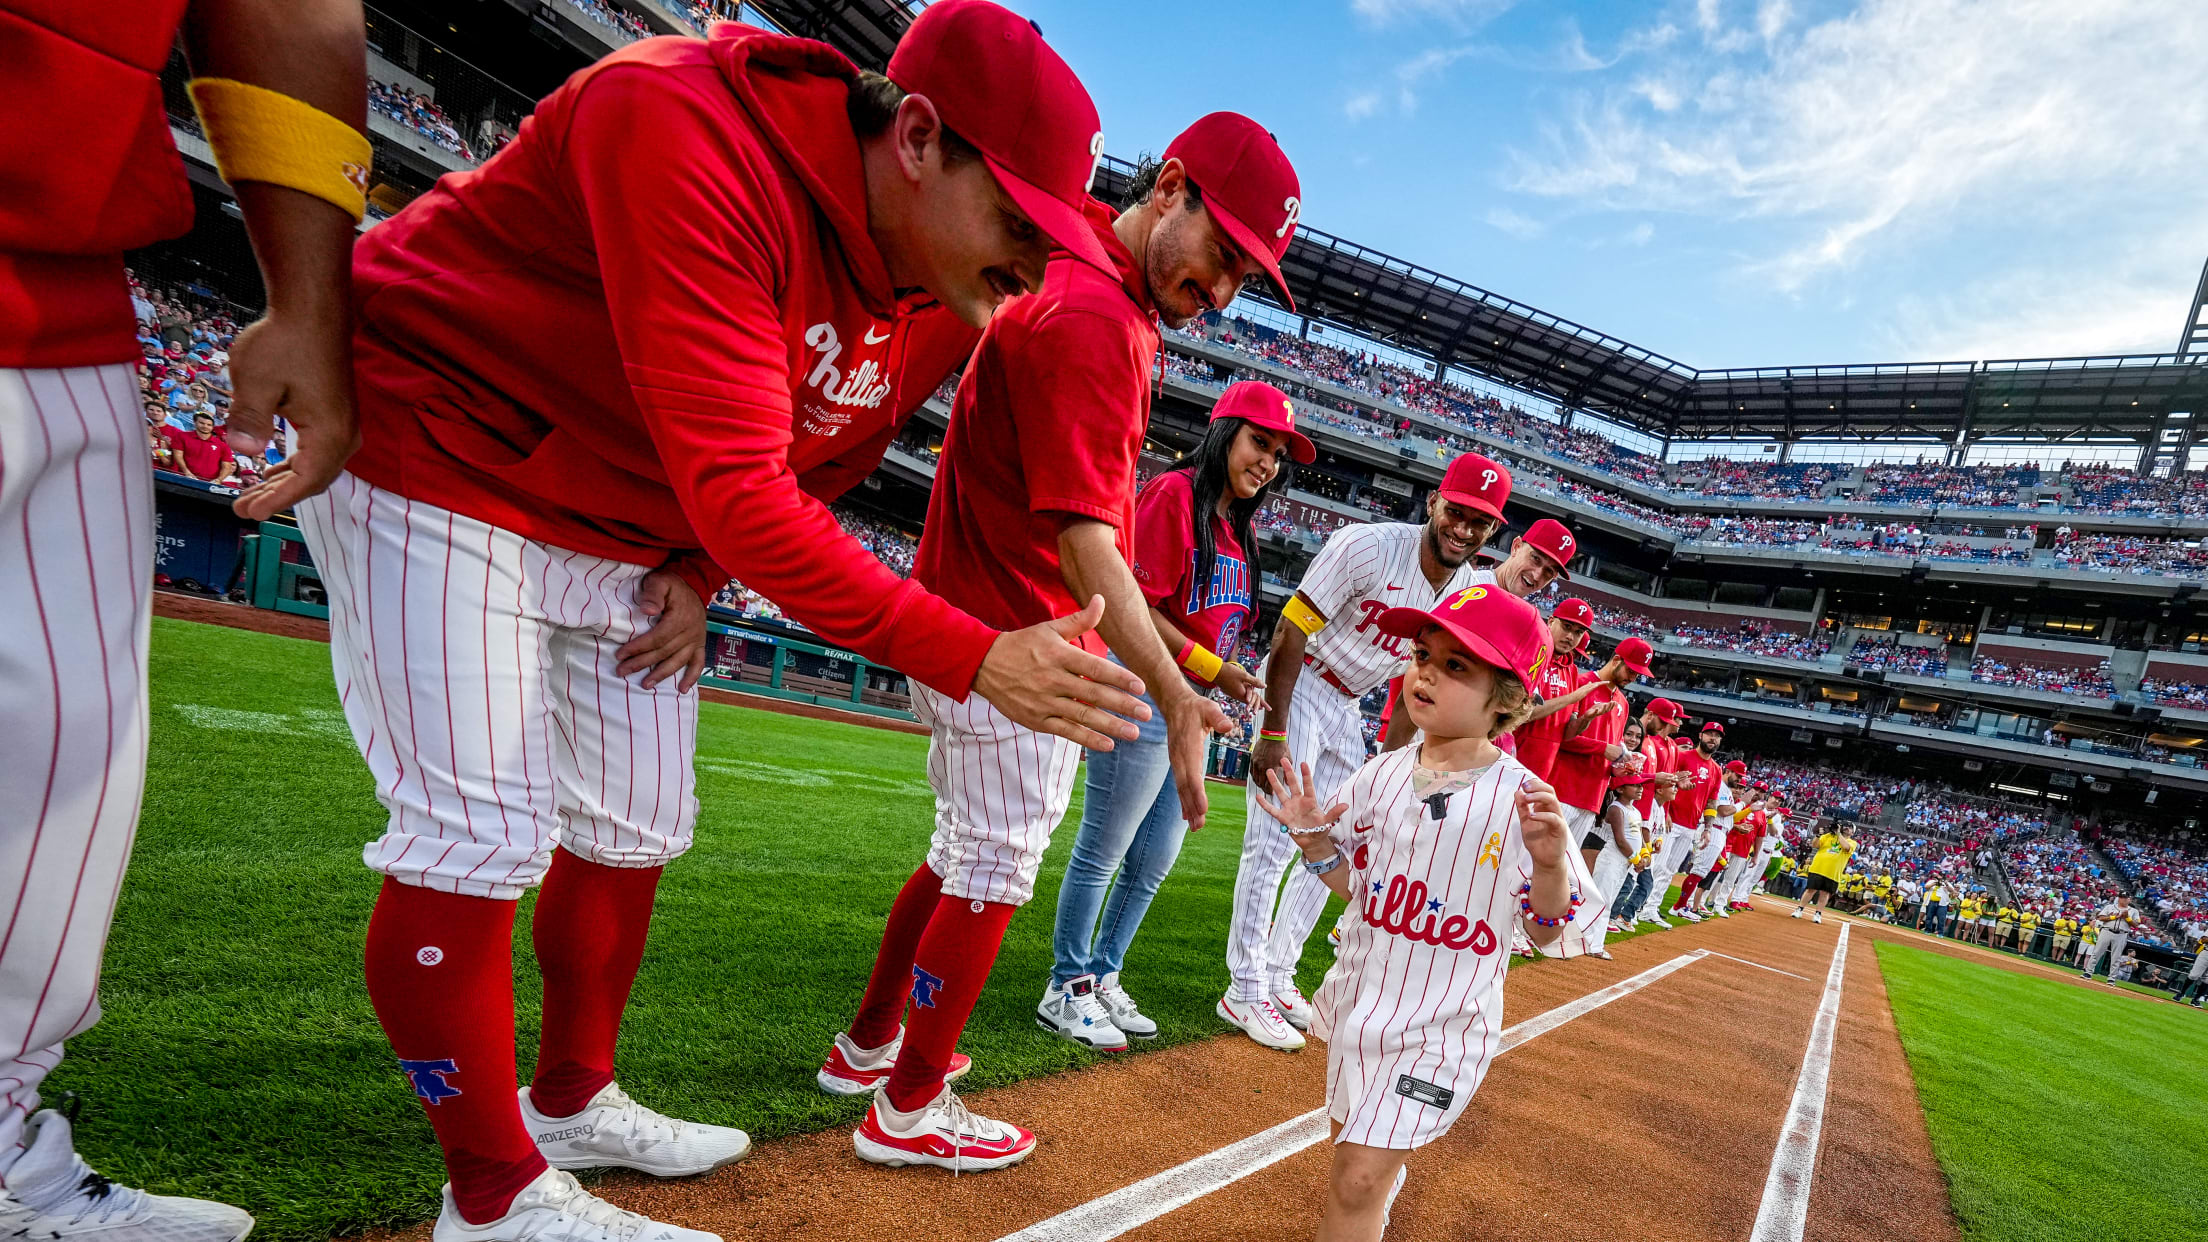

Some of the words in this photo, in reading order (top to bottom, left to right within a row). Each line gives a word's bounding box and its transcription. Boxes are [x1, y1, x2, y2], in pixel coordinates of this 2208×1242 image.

[1276, 196, 1301, 239] P
[1480, 469, 1498, 491] P
[1271, 498, 1291, 516] OF
[1558, 535, 1573, 551] P
[1449, 586, 1488, 611] P
[1578, 605, 1588, 616] P
[727, 629, 768, 643] smartwater
[824, 649, 854, 662] RE/MAX
[818, 668, 846, 680] Citizens
[536, 1124, 593, 1145] ADIZERO
